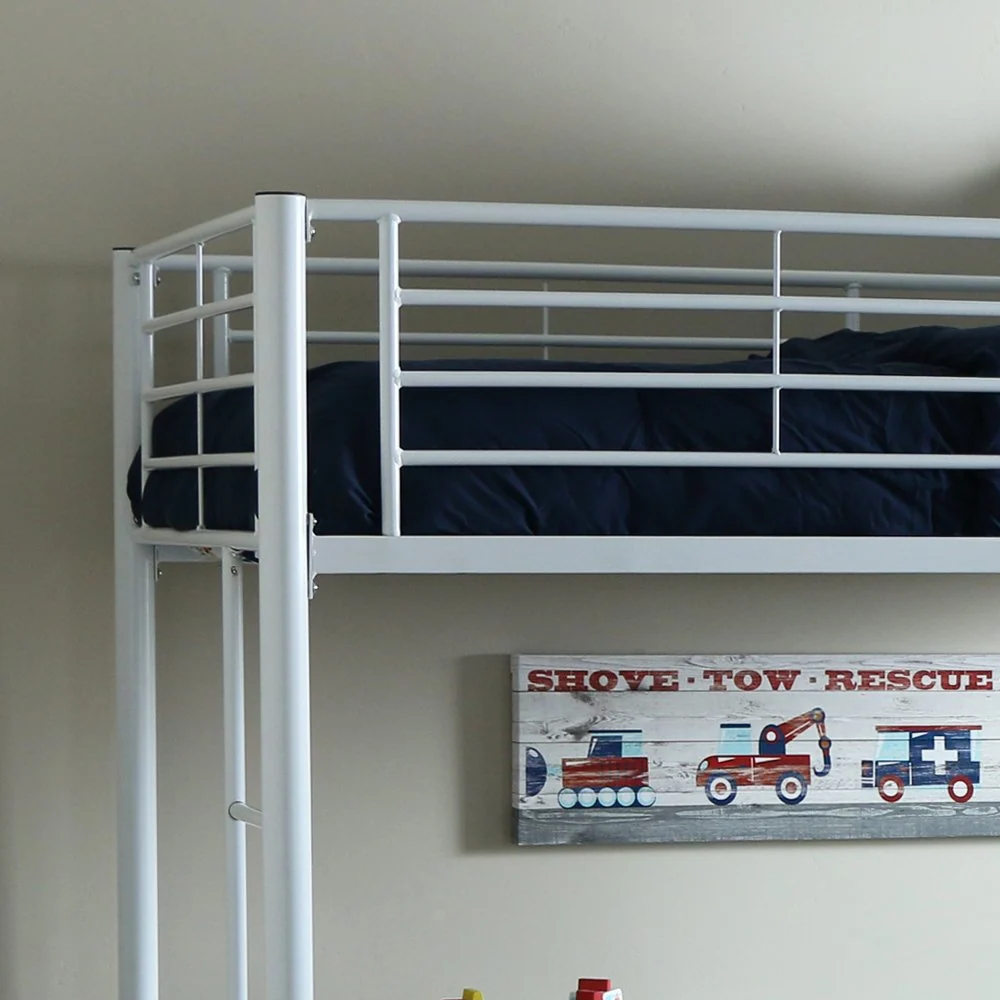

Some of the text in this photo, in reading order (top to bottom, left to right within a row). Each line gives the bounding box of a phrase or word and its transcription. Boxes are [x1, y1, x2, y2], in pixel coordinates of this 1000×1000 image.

[527, 669, 679, 692] SHOVE
[702, 669, 801, 691] TOW
[824, 669, 994, 691] RESCUE
